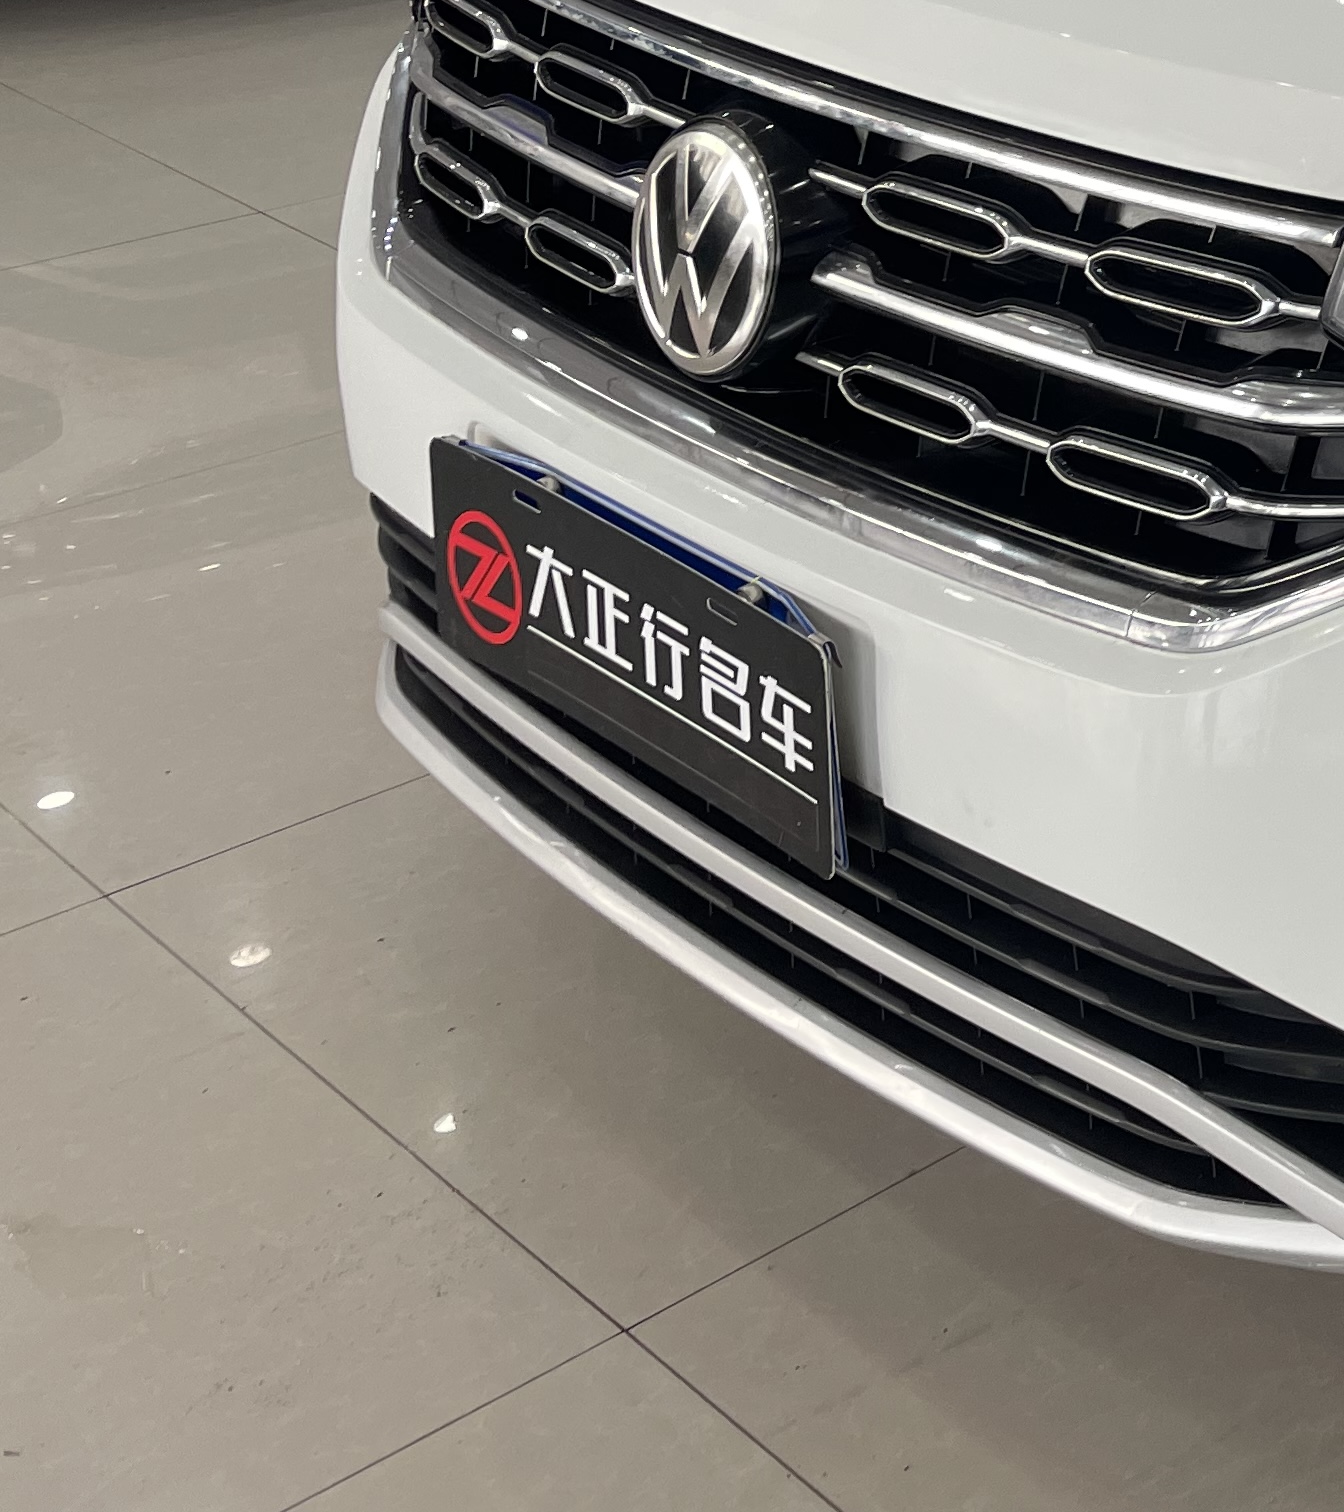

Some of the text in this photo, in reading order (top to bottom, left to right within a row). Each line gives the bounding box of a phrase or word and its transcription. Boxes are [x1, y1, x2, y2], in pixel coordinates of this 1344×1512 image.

[525, 543, 815, 773] 大正行名车
